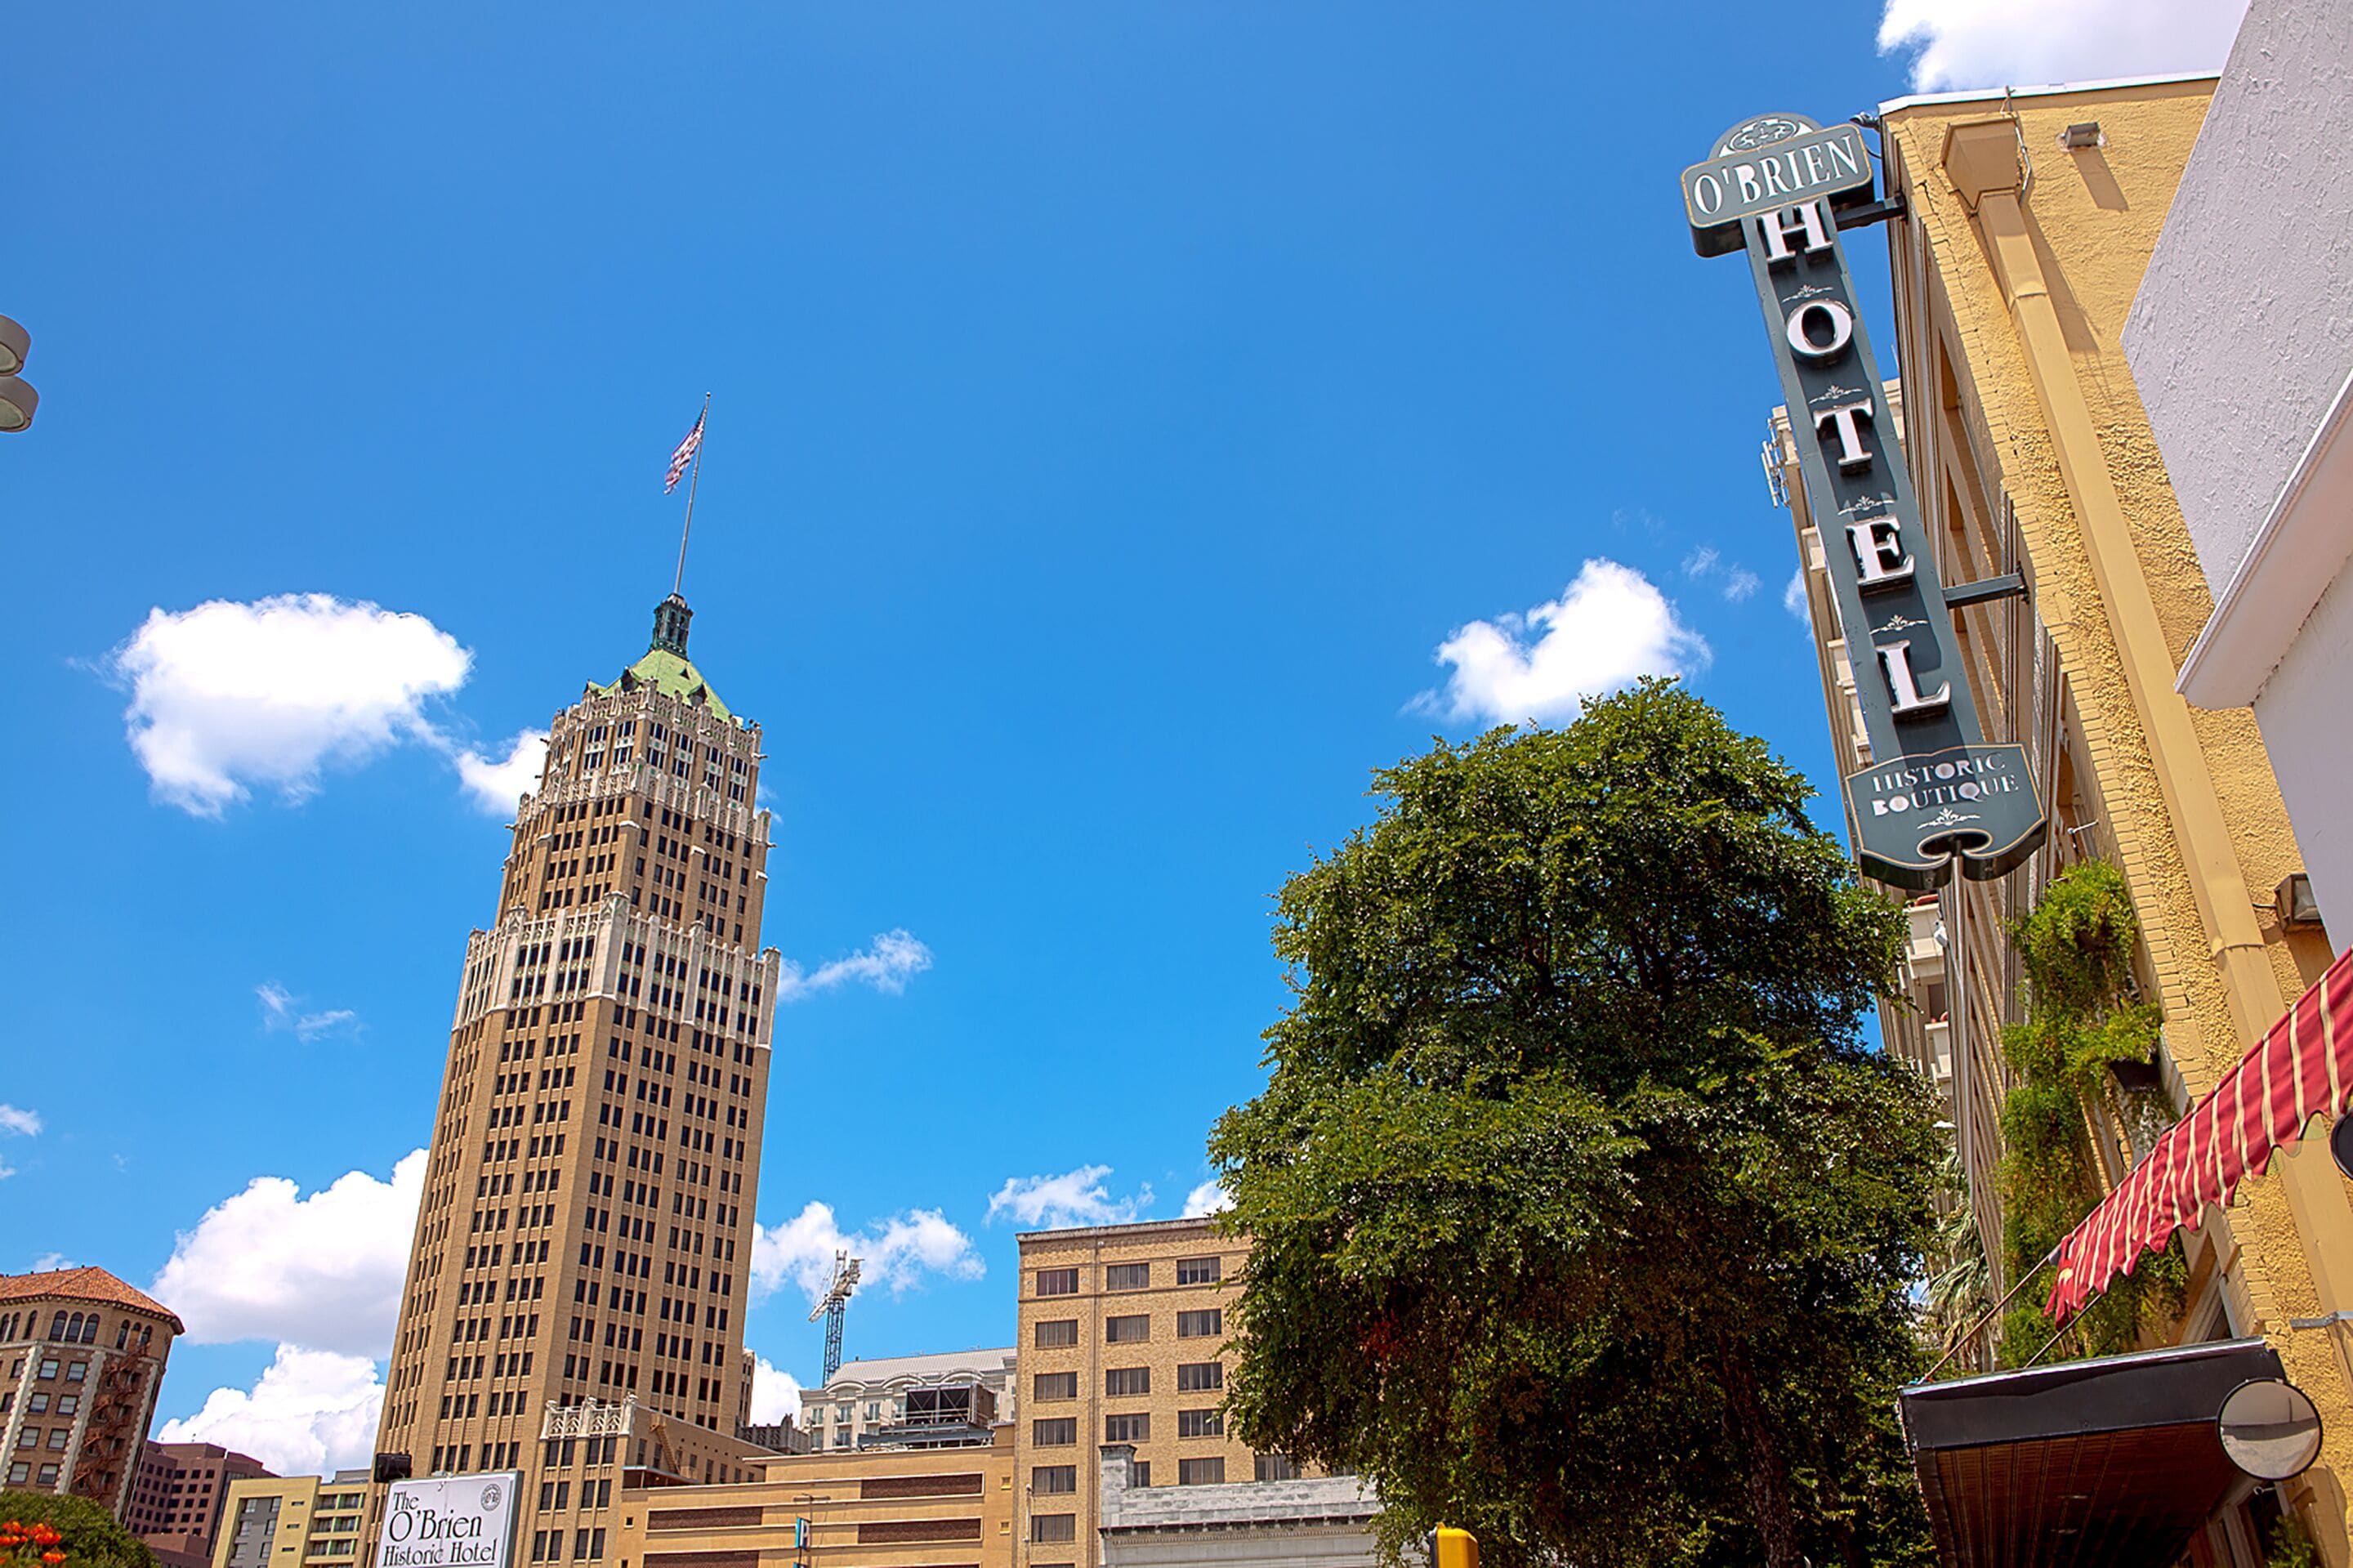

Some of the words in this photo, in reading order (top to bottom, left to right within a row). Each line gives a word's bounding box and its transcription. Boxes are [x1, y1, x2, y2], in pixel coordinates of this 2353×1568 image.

[1694, 135, 1859, 214] O'BRIEN
[1757, 199, 1951, 714] HOTEL
[1873, 752, 2006, 793] HISTORIC
[1871, 774, 2019, 816] BOUTIQUE
[393, 1490, 419, 1512] The
[389, 1509, 482, 1543] O'Brien
[382, 1543, 444, 1567] Historic
[450, 1538, 497, 1563] Hotel
